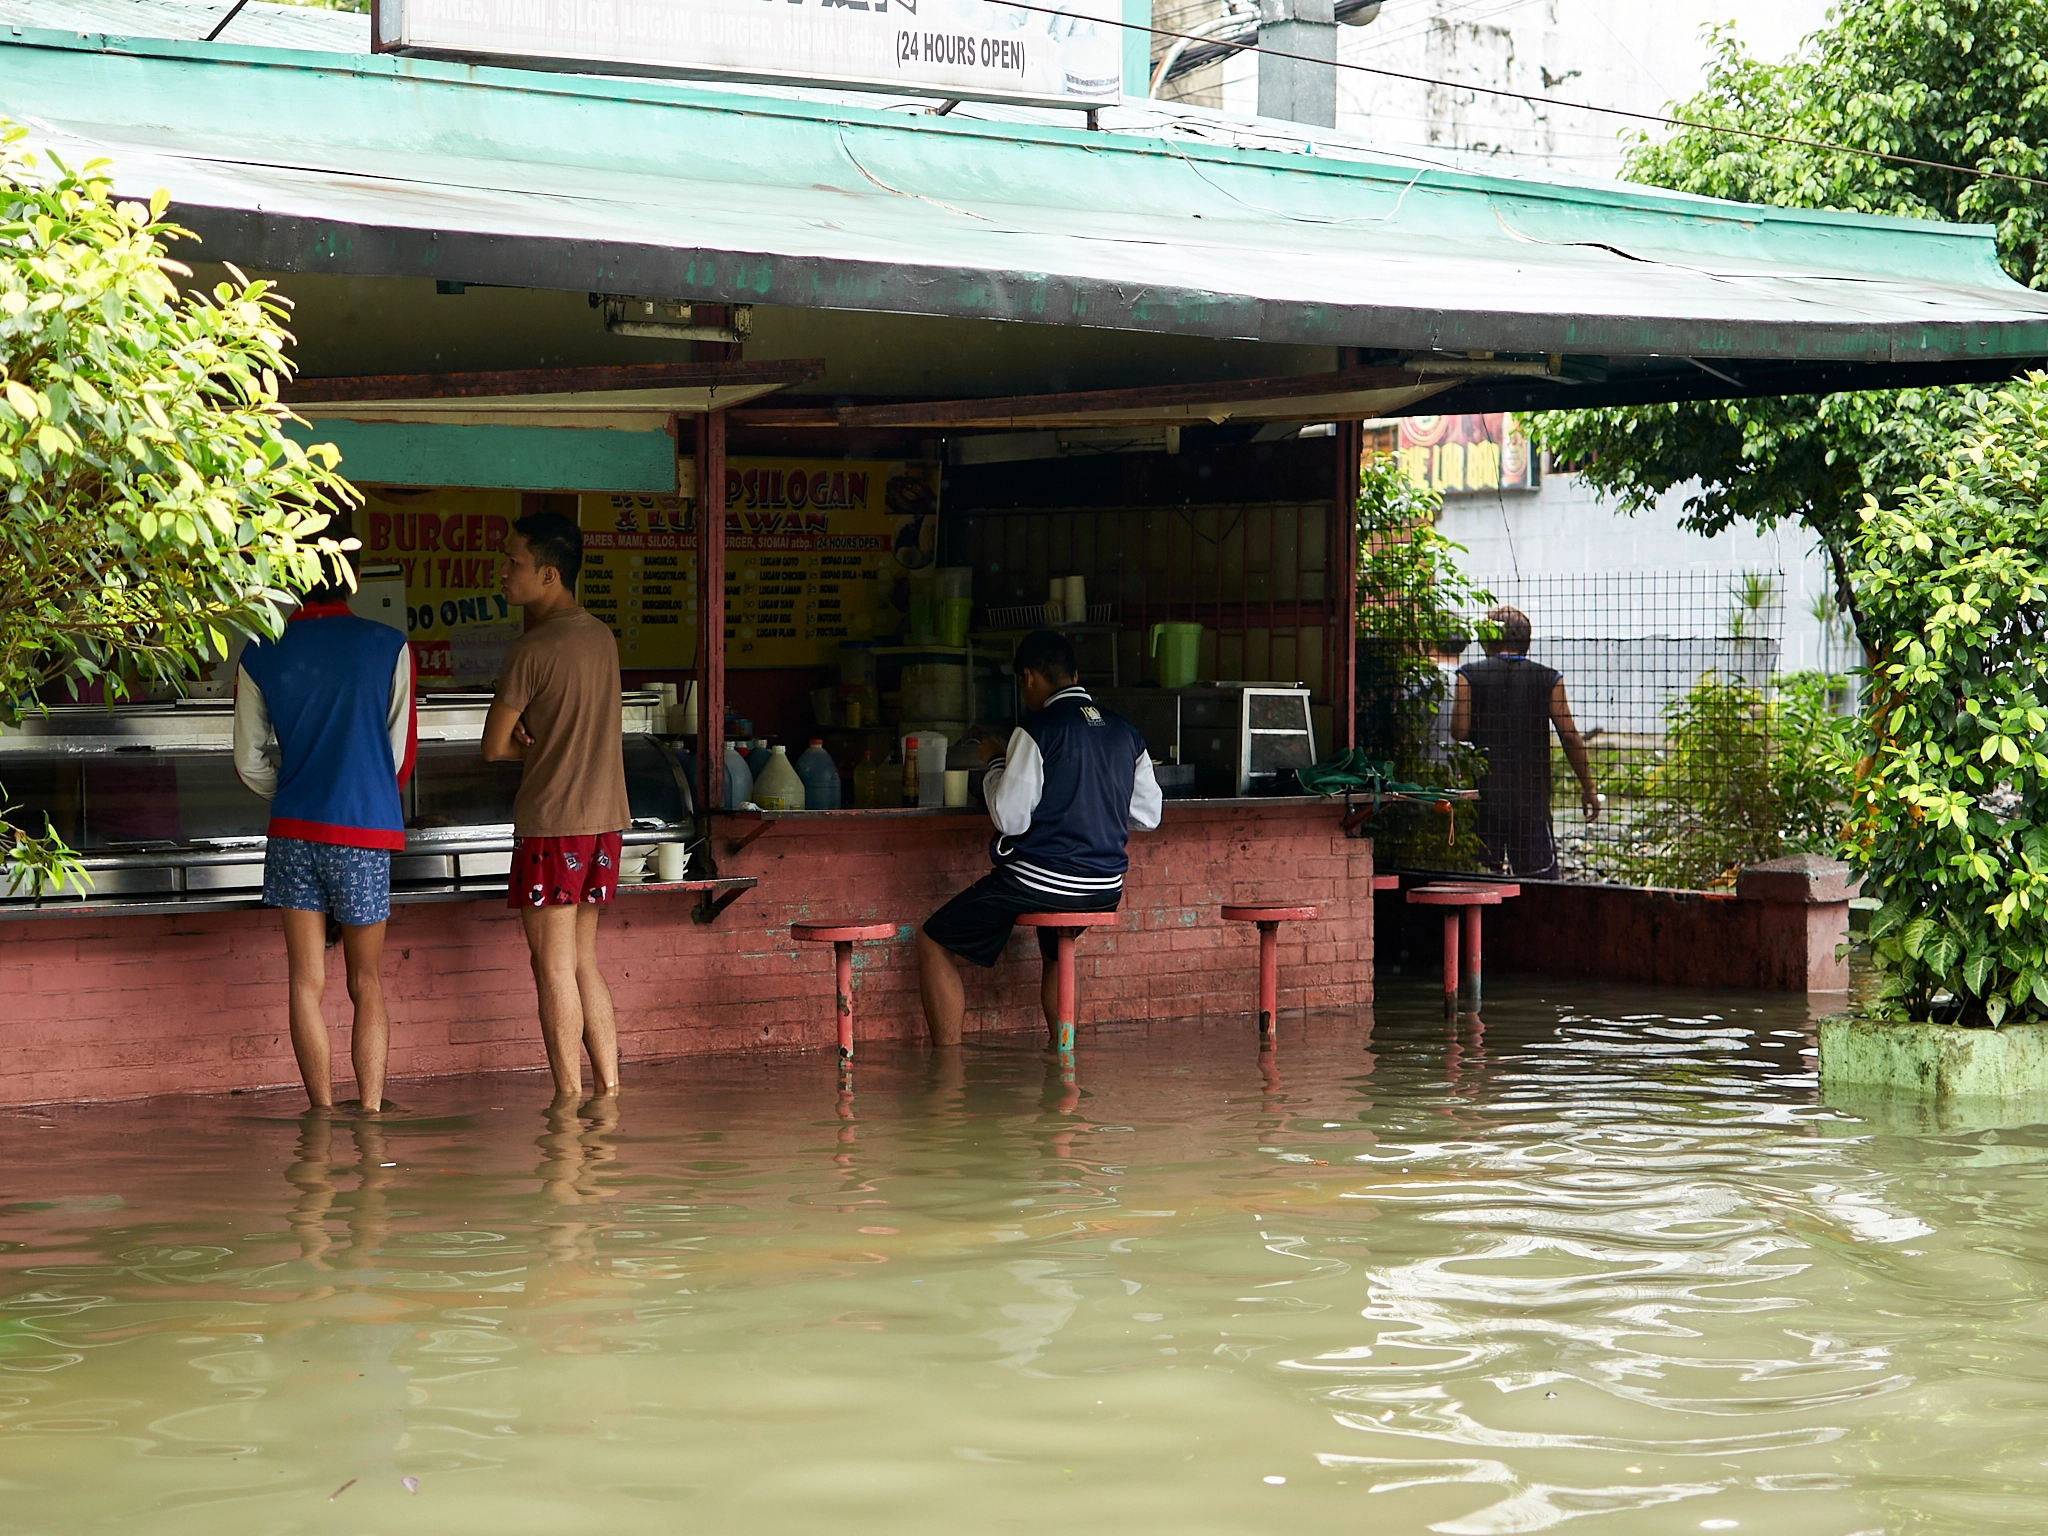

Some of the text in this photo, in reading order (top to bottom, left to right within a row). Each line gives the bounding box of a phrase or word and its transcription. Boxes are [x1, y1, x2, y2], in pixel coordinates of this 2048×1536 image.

[625, 5, 694, 48] LUGAW,
[700, 12, 777, 56] BURGER,
[782, 19, 843, 54] SIOMAI
[896, 30, 919, 67] (24
[923, 34, 976, 65] HOURS
[980, 37, 1025, 78] OPEN)
[369, 512, 508, 551] BURGER
[583, 534, 615, 549] PARES,
[617, 535, 645, 549] MAMI,
[648, 535, 678, 549] SILOG,
[758, 537, 789, 549] SIOMAI
[830, 537, 857, 549] HOURS
[423, 557, 431, 588] 1
[438, 557, 495, 589] TAKE
[441, 595, 508, 626] ONLY
